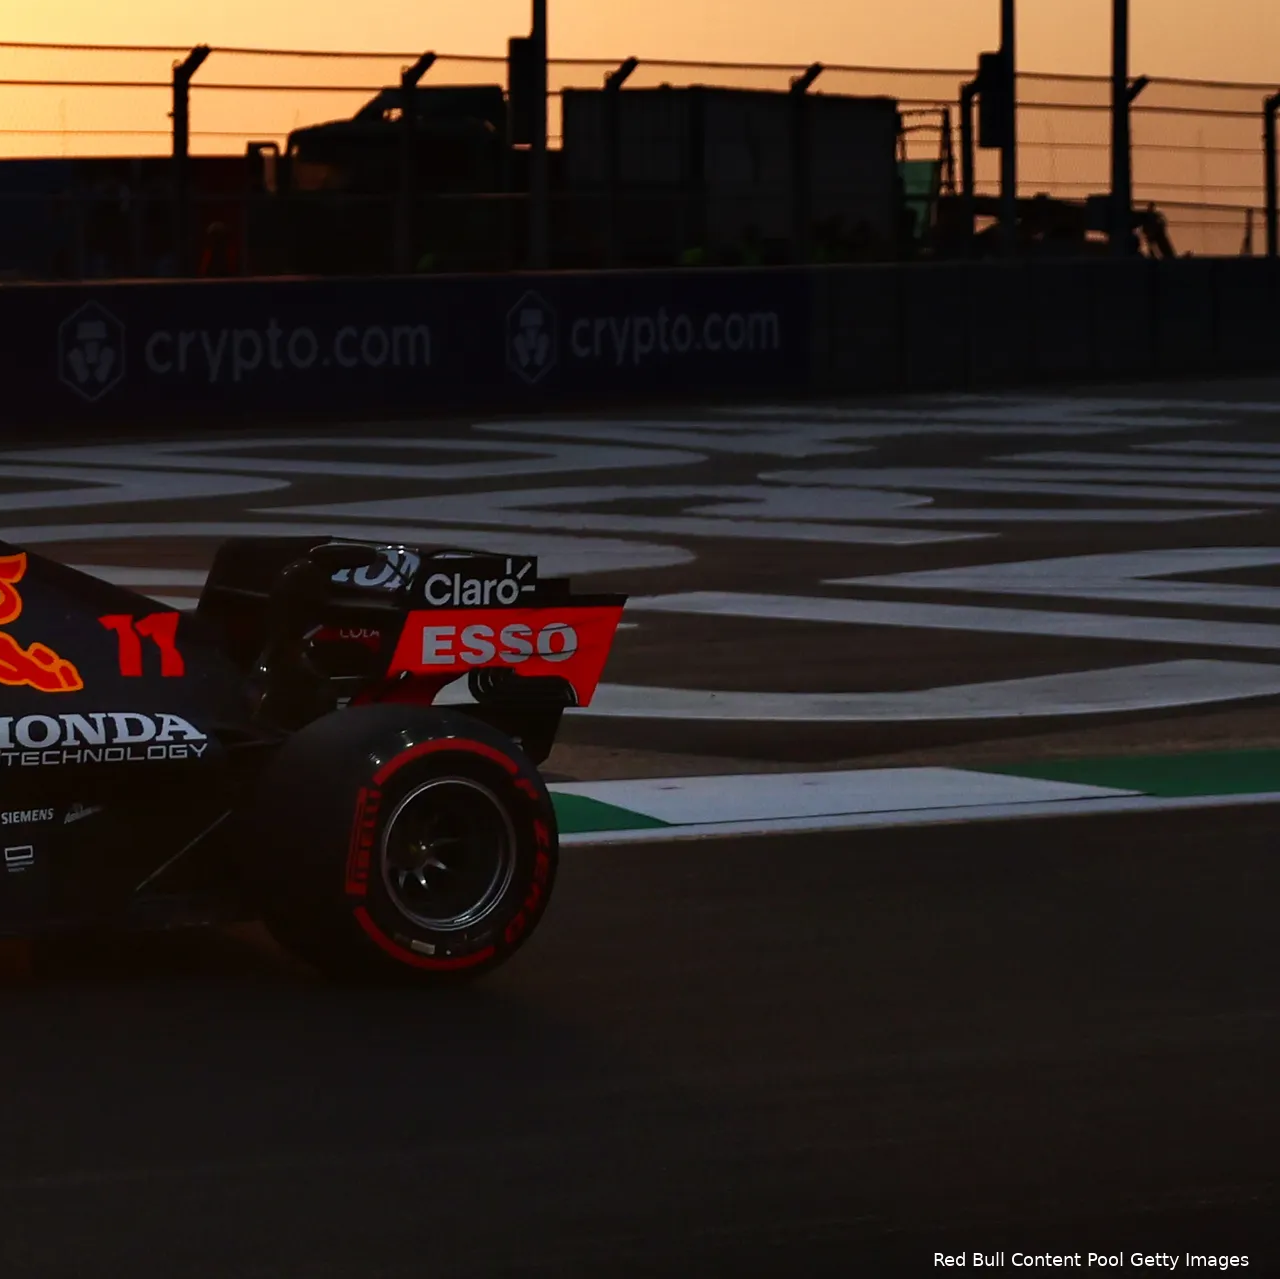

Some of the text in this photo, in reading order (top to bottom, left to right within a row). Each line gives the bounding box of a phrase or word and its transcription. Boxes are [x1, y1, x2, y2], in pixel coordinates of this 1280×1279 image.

[145, 318, 432, 382] crypto.com
[570, 306, 780, 368] crypto.com
[424, 570, 520, 607] Claro
[97, 611, 187, 677] 11
[421, 622, 579, 665] ESSO
[1, 808, 55, 825] SIEMENS
